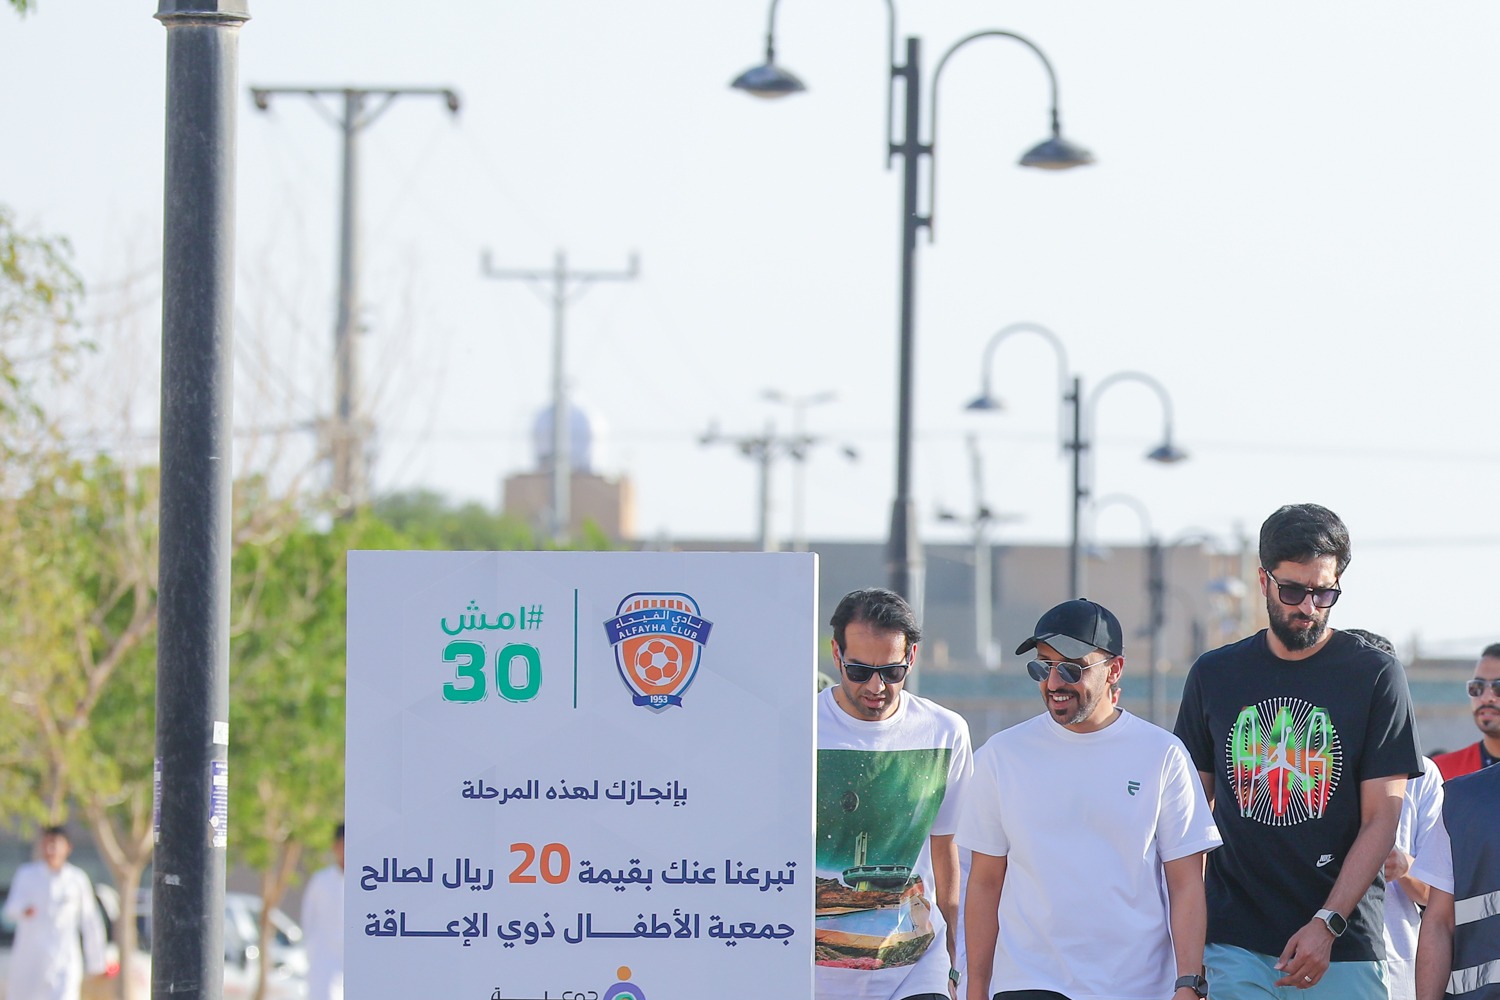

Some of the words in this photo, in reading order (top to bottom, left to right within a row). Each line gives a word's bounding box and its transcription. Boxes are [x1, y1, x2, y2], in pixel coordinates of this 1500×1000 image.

[441, 600, 545, 636] #امش
[616, 610, 670, 629] الفيحاء
[619, 623, 667, 640] ALFAYHA
[671, 625, 698, 640] CLUB
[671, 614, 704, 629] نادي
[442, 639, 543, 704] 30
[650, 695, 668, 704] 1953
[461, 779, 540, 805] المرحلة
[546, 779, 599, 801] لهذه
[605, 780, 688, 807] بإنجازك
[360, 858, 434, 892] لصالح
[442, 858, 494, 892] ريال
[508, 842, 572, 885] 20
[578, 858, 653, 892] بقيمة
[661, 858, 717, 885] عنك
[725, 859, 798, 892] تبرعنا
[364, 908, 489, 947] الإعاقة
[497, 911, 556, 949] ذوي
[563, 908, 700, 945] الأطفال
[708, 914, 795, 948] جمعية
